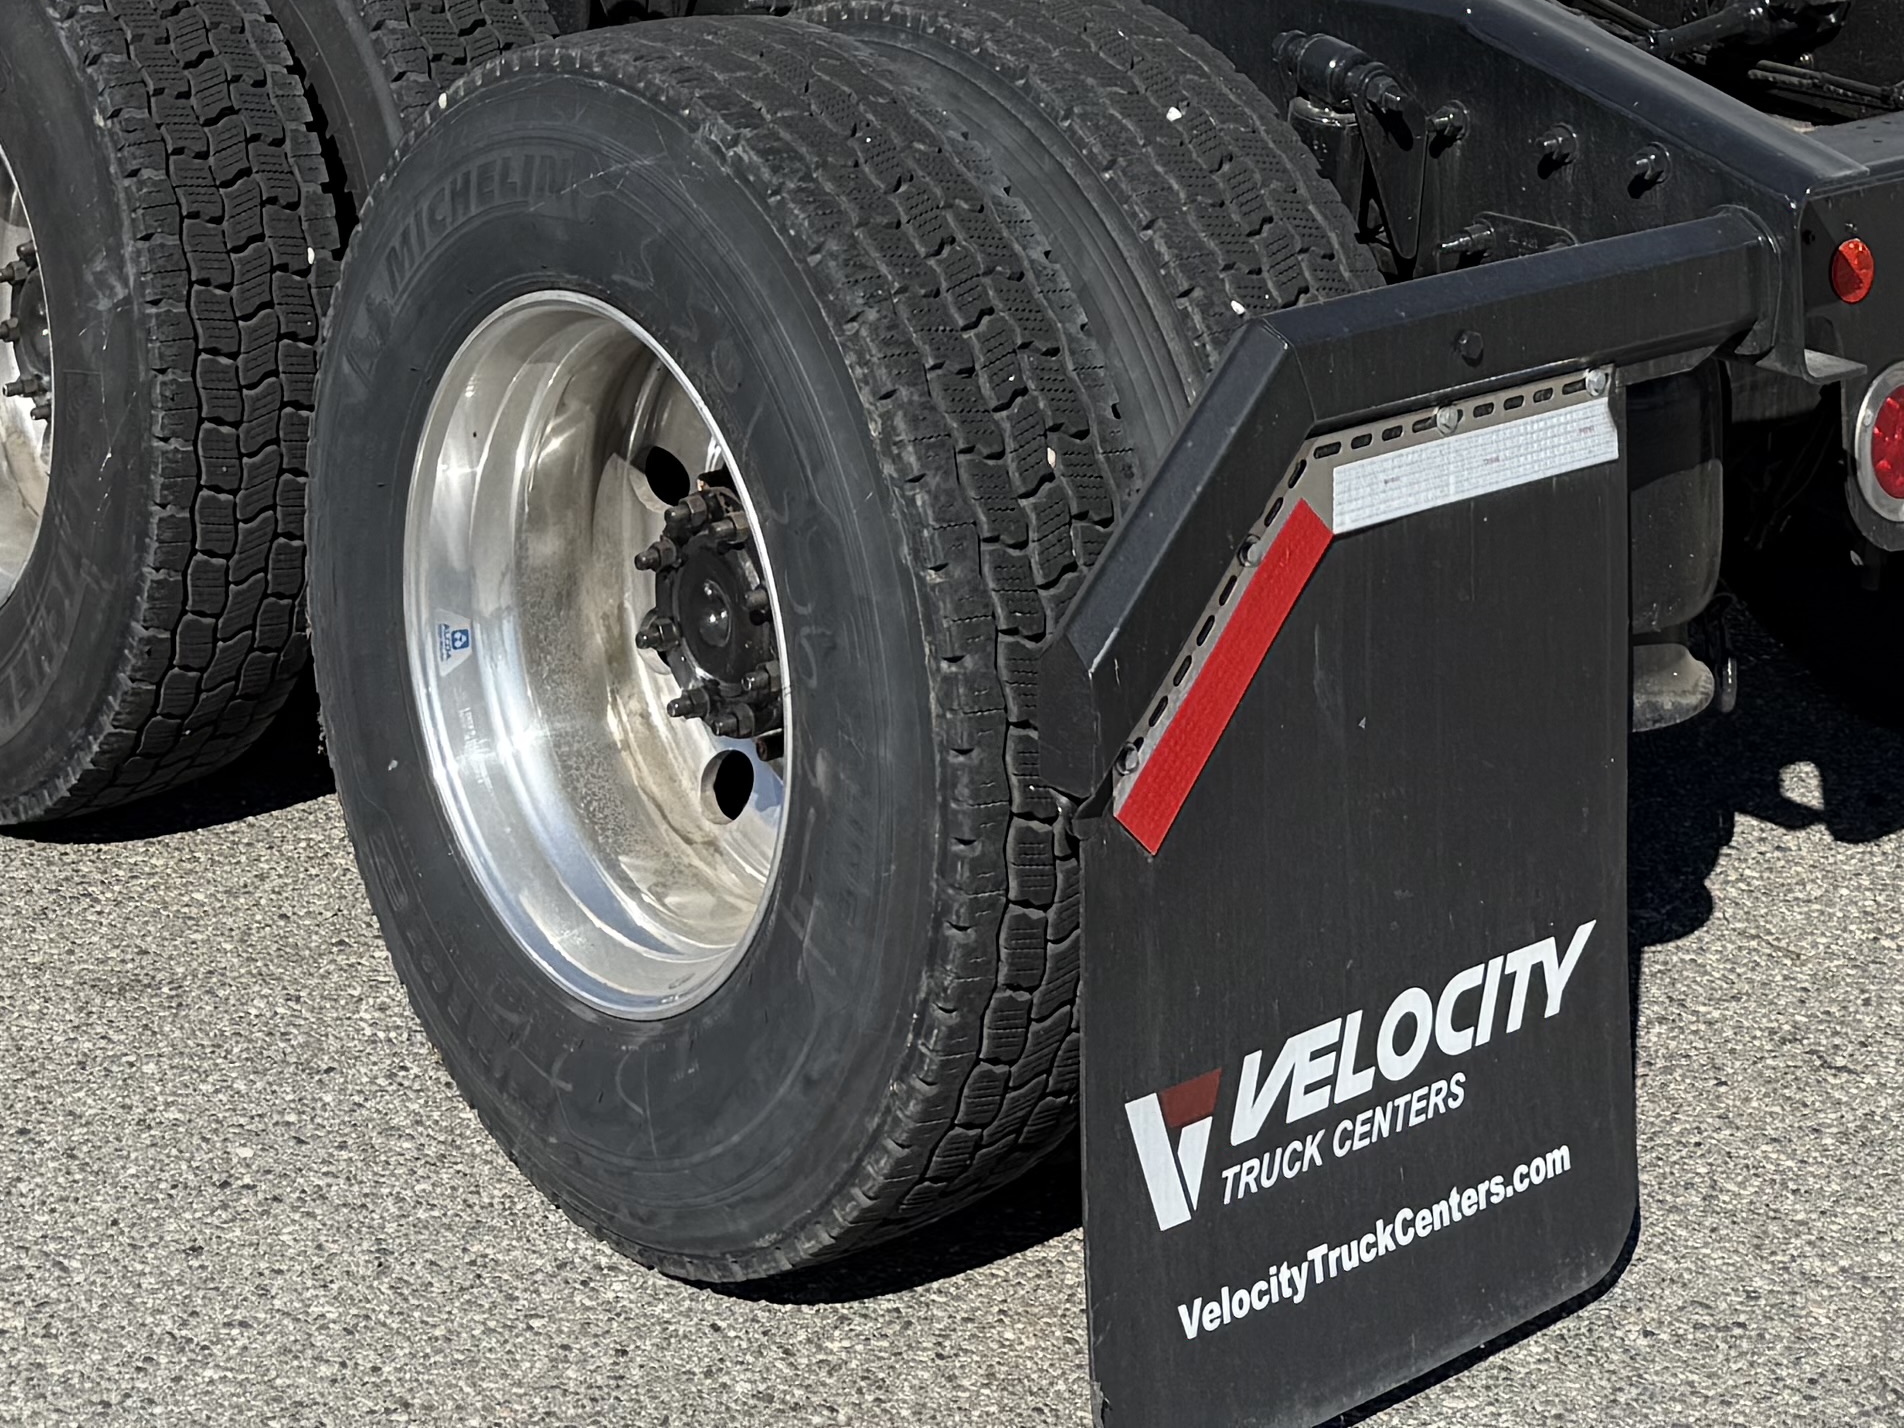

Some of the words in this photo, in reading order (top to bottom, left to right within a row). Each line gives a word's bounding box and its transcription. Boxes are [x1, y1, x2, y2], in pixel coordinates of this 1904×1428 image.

[383, 152, 575, 295] MICHELIN
[1230, 919, 1597, 1147] VELOCITY
[1221, 1128, 1326, 1205] TRUCK
[1332, 1072, 1466, 1158] CENTERS
[1177, 1144, 1571, 1340] VelocityTruckCenters.com
